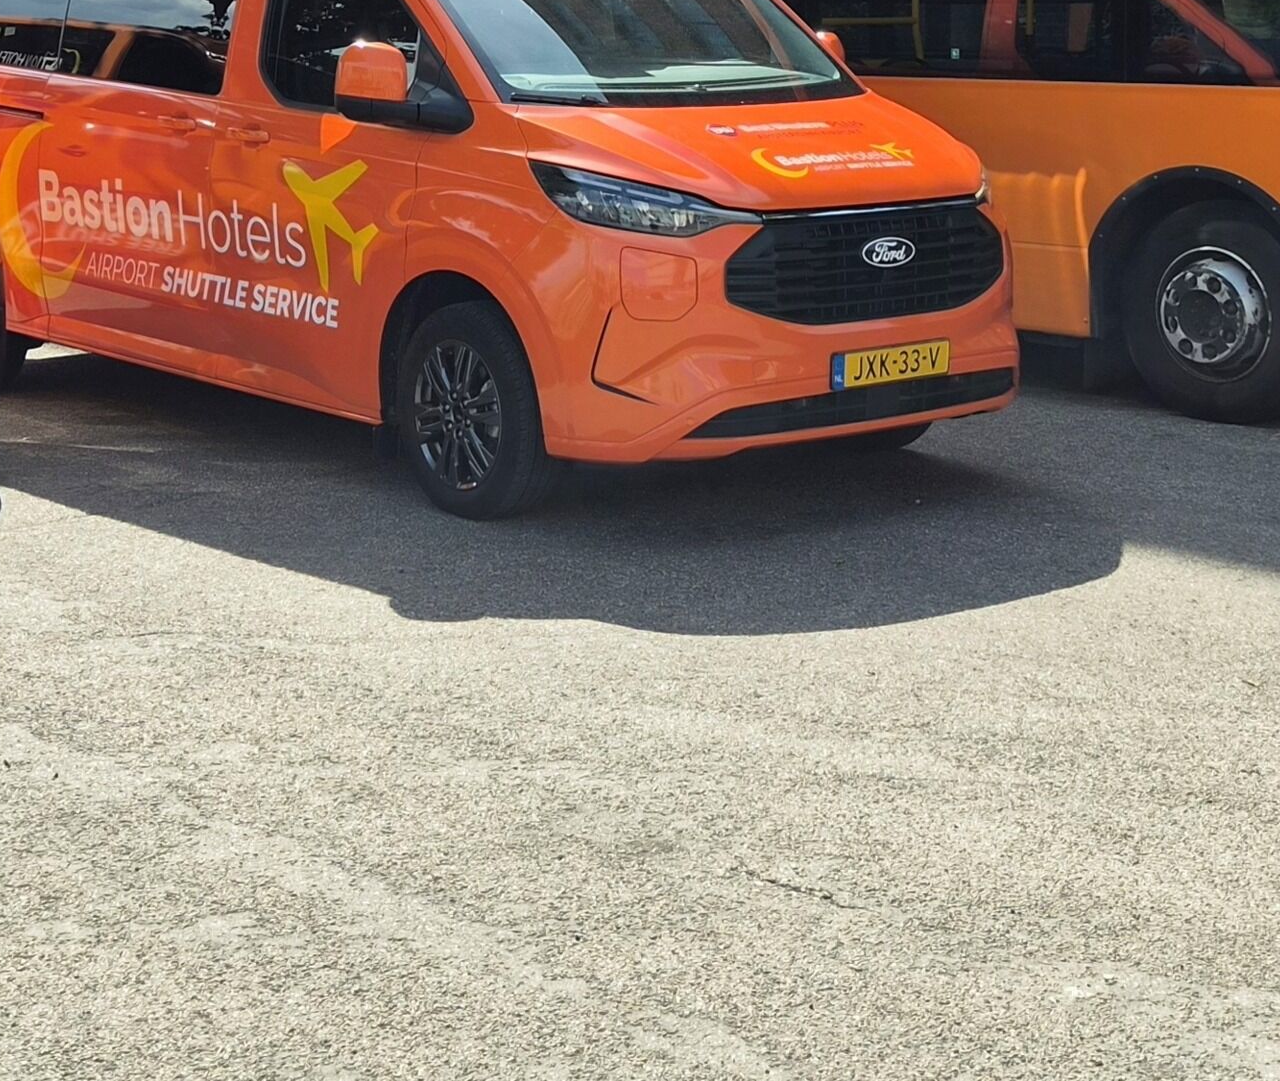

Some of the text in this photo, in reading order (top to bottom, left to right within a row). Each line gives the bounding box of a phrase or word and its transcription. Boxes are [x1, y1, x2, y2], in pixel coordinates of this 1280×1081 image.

[872, 241, 906, 262] Ford
[85, 251, 339, 328] AIRPORT SHUTTLE SERVICE
[853, 345, 940, 381] JXK-33-V
